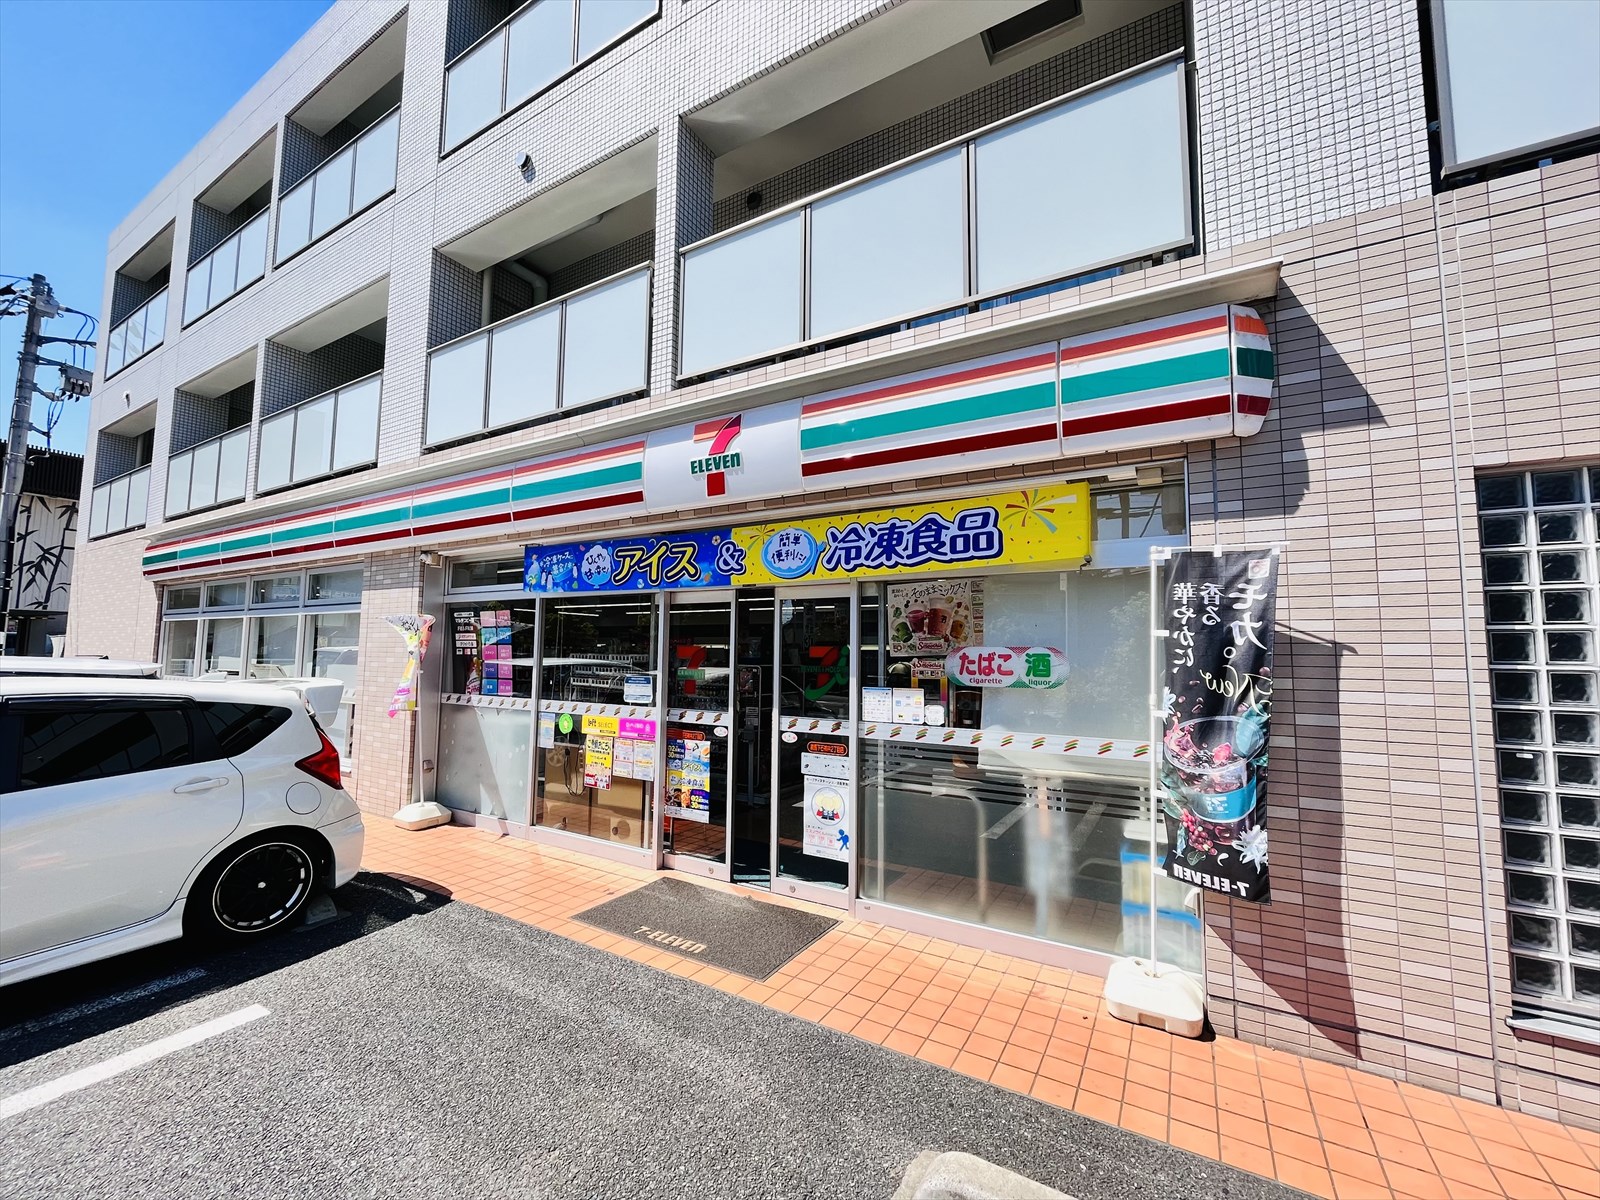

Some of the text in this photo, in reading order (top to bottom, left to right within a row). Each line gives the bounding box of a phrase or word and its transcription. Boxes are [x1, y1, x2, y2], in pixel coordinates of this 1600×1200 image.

[779, 532, 802, 548] 簡単
[825, 508, 1000, 569] 冷凍食品
[613, 541, 746, 584] アイス &
[959, 651, 1014, 676] たばこ
[1025, 652, 1051, 678] 酒
[969, 677, 1003, 685] cigarette
[1028, 679, 1052, 687] liquor
